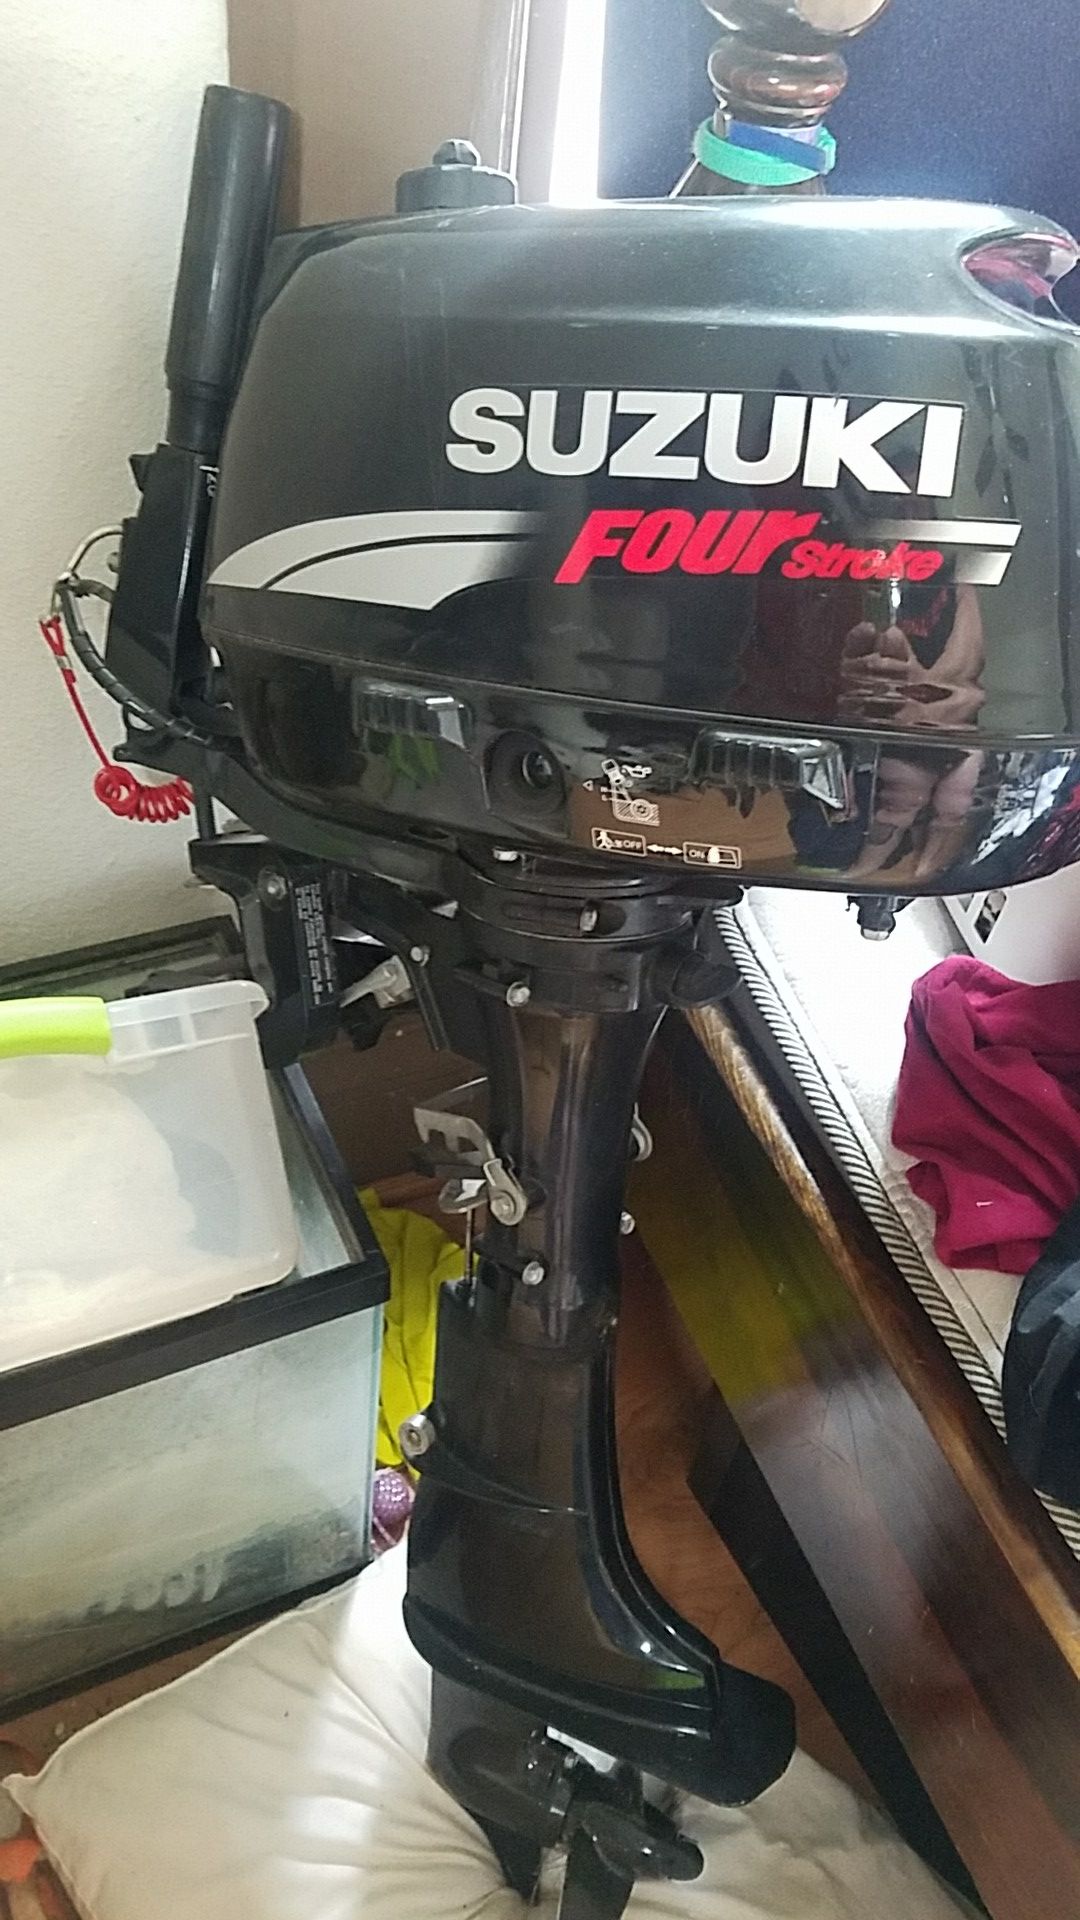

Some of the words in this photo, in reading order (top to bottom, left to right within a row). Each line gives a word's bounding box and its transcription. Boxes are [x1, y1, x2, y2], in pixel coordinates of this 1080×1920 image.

[445, 387, 965, 497] SUZUKI
[781, 539, 944, 581] Stroke
[623, 840, 642, 849] OFF
[689, 849, 705, 859] ON
